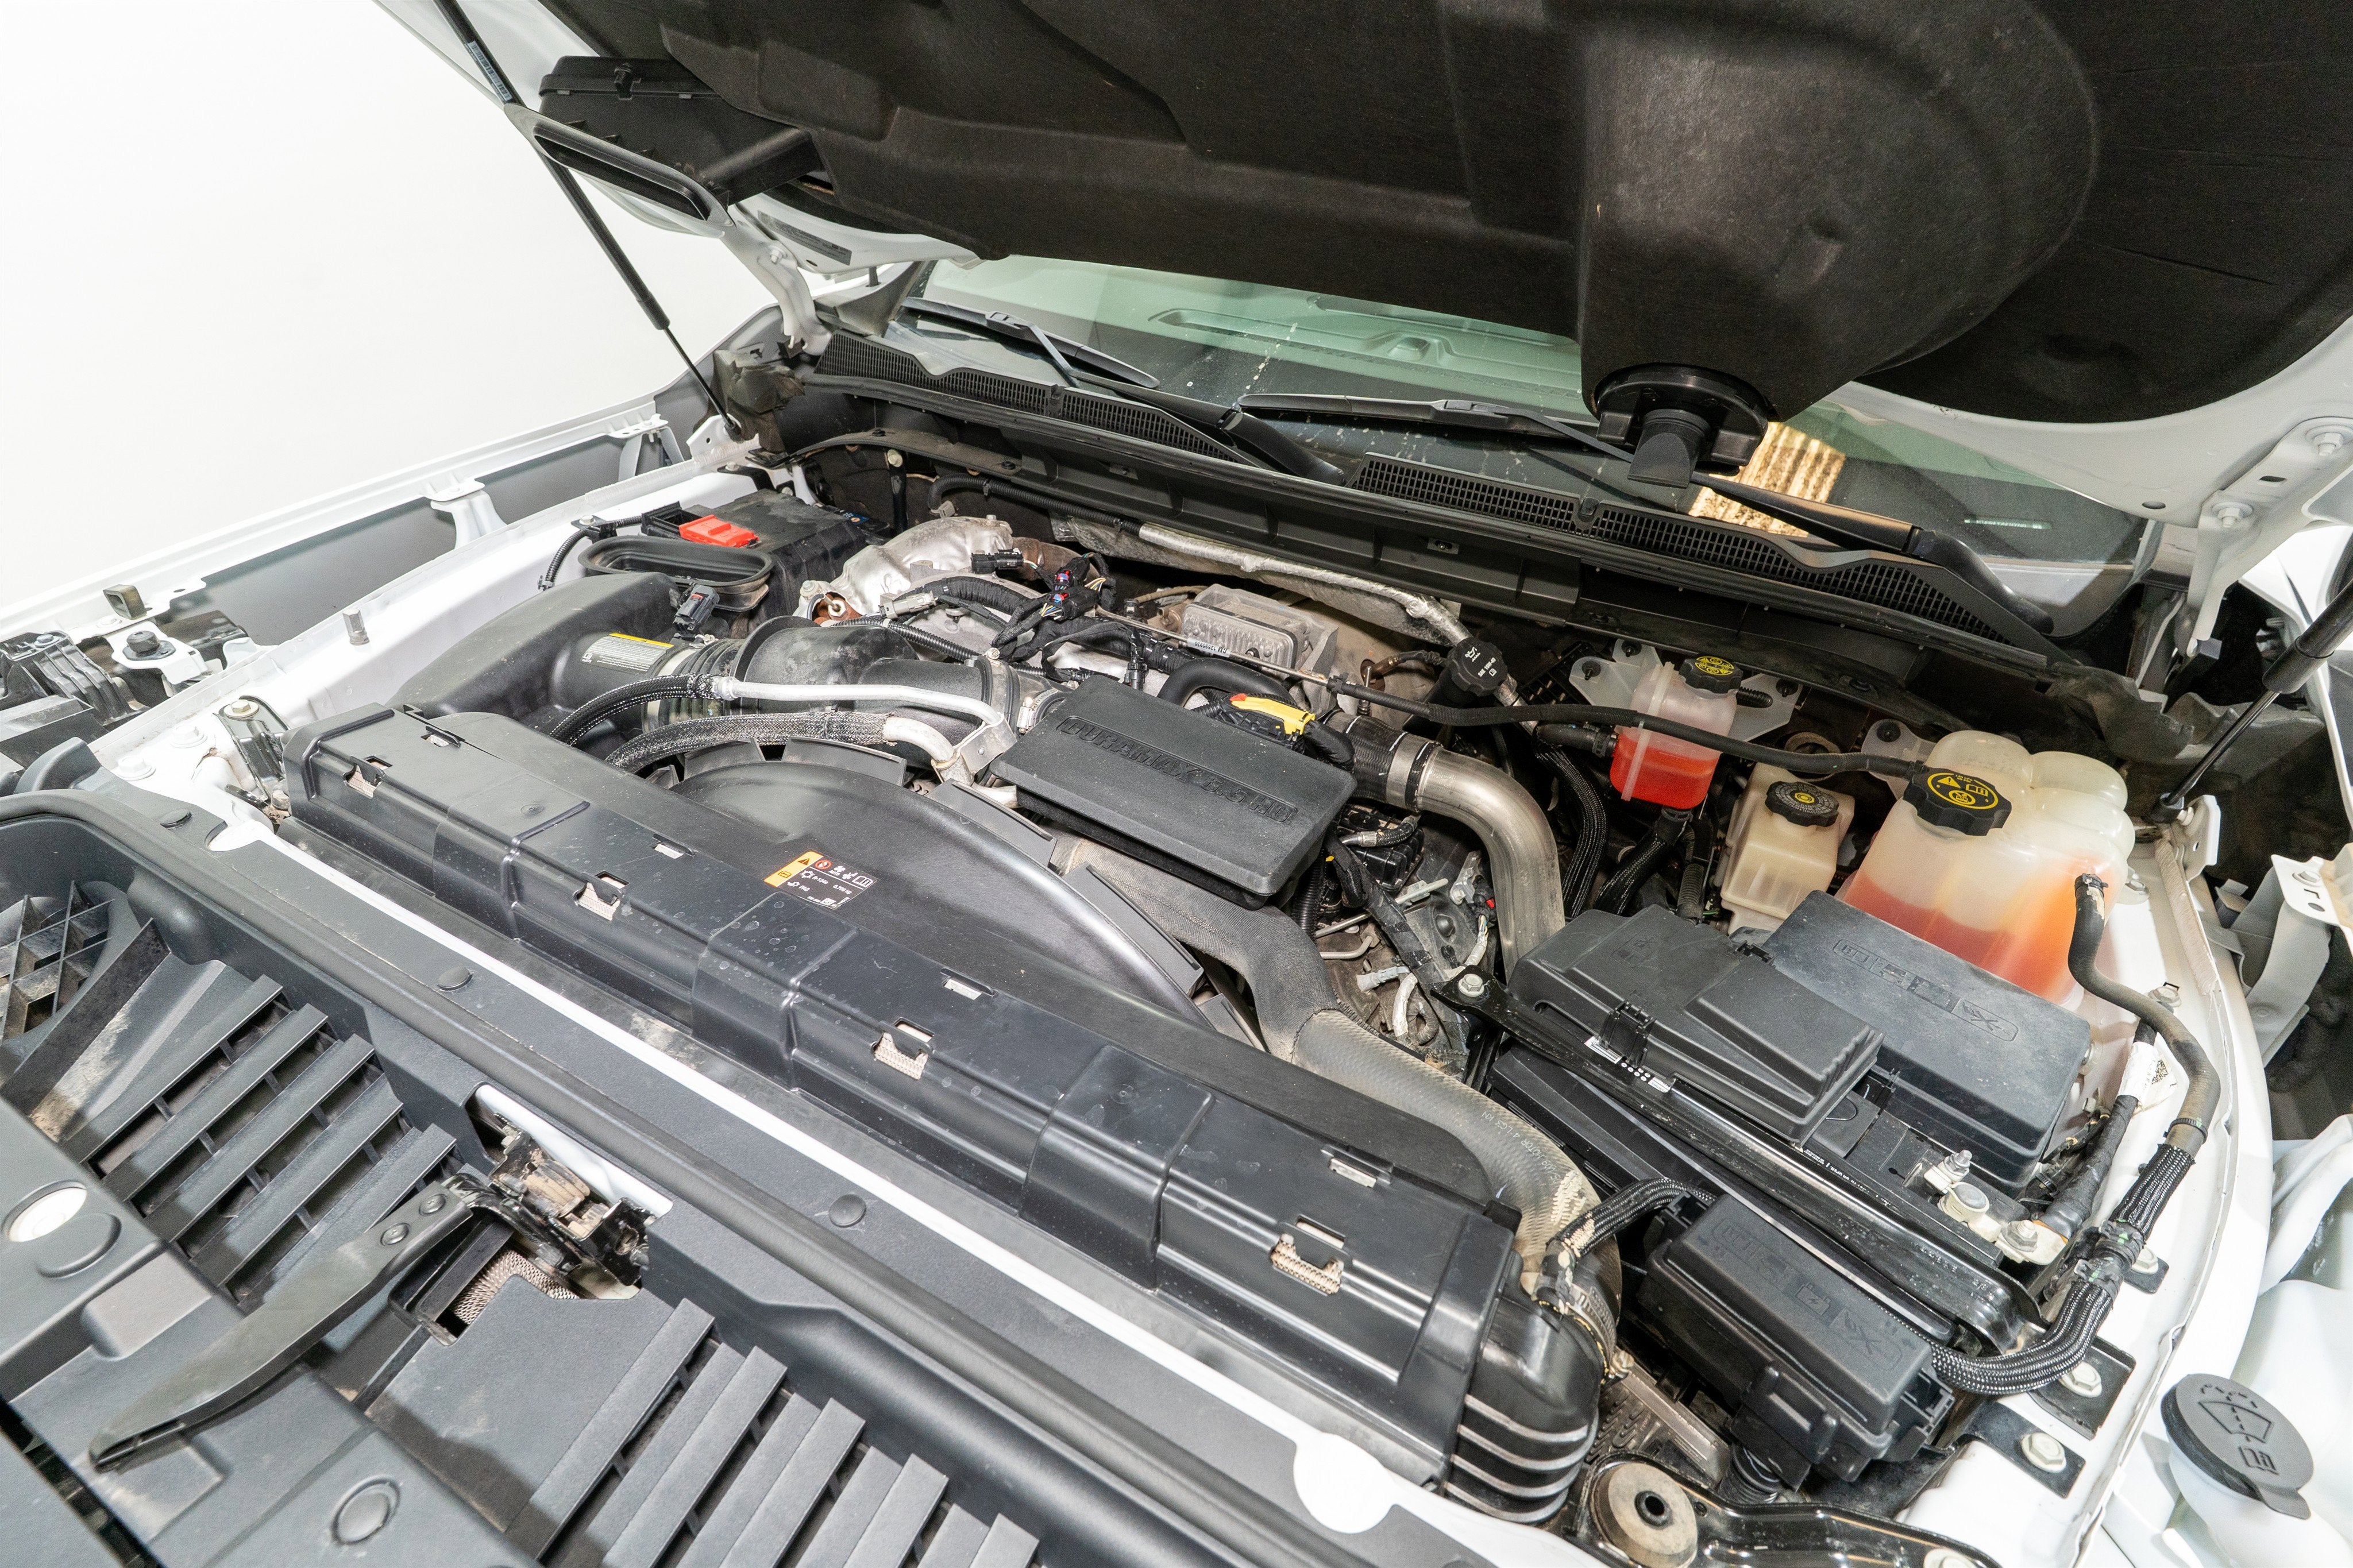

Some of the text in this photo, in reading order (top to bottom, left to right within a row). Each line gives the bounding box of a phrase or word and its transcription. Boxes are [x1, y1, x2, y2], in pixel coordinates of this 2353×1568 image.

[1478, 668, 1486, 677] SAE
[1060, 721, 1201, 785] DURAMAX
[1248, 793, 1293, 822] HD
[1521, 1138, 1545, 1159] MOTOR
